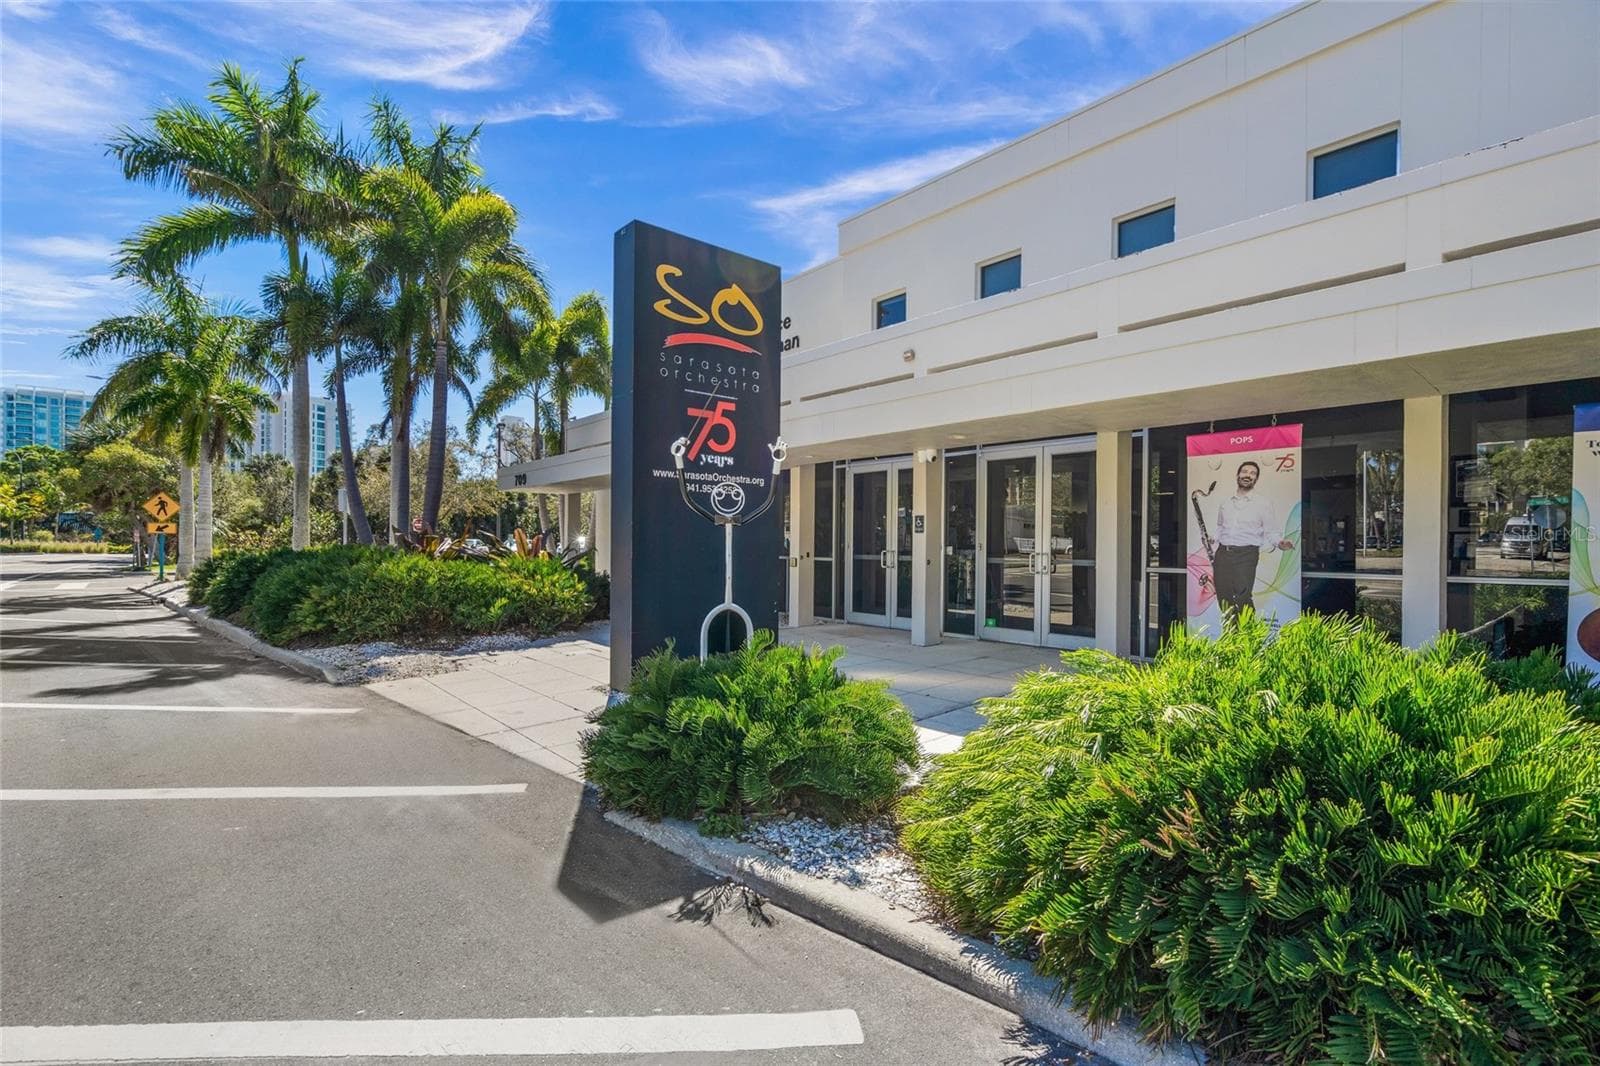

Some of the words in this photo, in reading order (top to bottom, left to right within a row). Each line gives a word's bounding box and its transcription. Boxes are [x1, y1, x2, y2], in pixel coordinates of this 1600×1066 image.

[653, 263, 764, 336] SO
[659, 351, 760, 380] sarasota
[659, 367, 760, 393] orchestra
[687, 401, 736, 461] 75
[1230, 435, 1254, 444] POPS
[700, 454, 734, 468] years
[1275, 453, 1295, 472] 75
